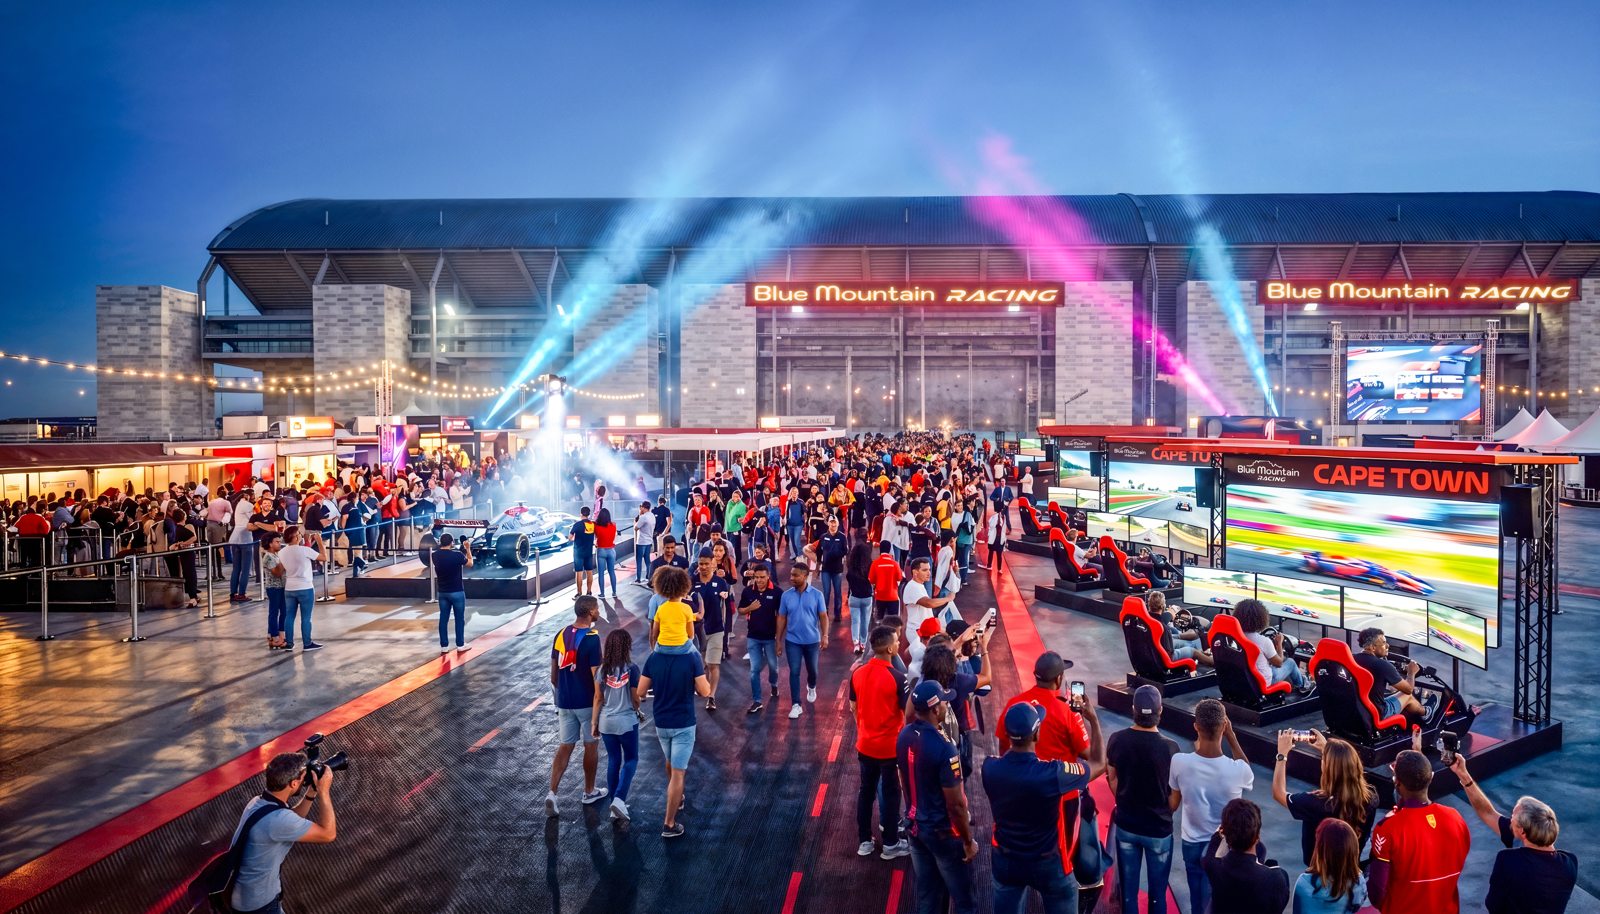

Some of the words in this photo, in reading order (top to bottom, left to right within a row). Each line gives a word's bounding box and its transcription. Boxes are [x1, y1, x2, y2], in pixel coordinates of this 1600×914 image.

[754, 285, 808, 302] Blue
[815, 285, 935, 302] Mountain
[946, 289, 1059, 302] RACING
[1267, 282, 1322, 299] Blue
[1329, 282, 1449, 299] Mountain
[1460, 286, 1572, 299] RACING
[1151, 447, 1187, 462] CAPE
[1237, 464, 1256, 474] Blue
[1257, 465, 1300, 477] Mountain
[1313, 463, 1385, 488] CAPE
[1390, 467, 1489, 495] TOWN
